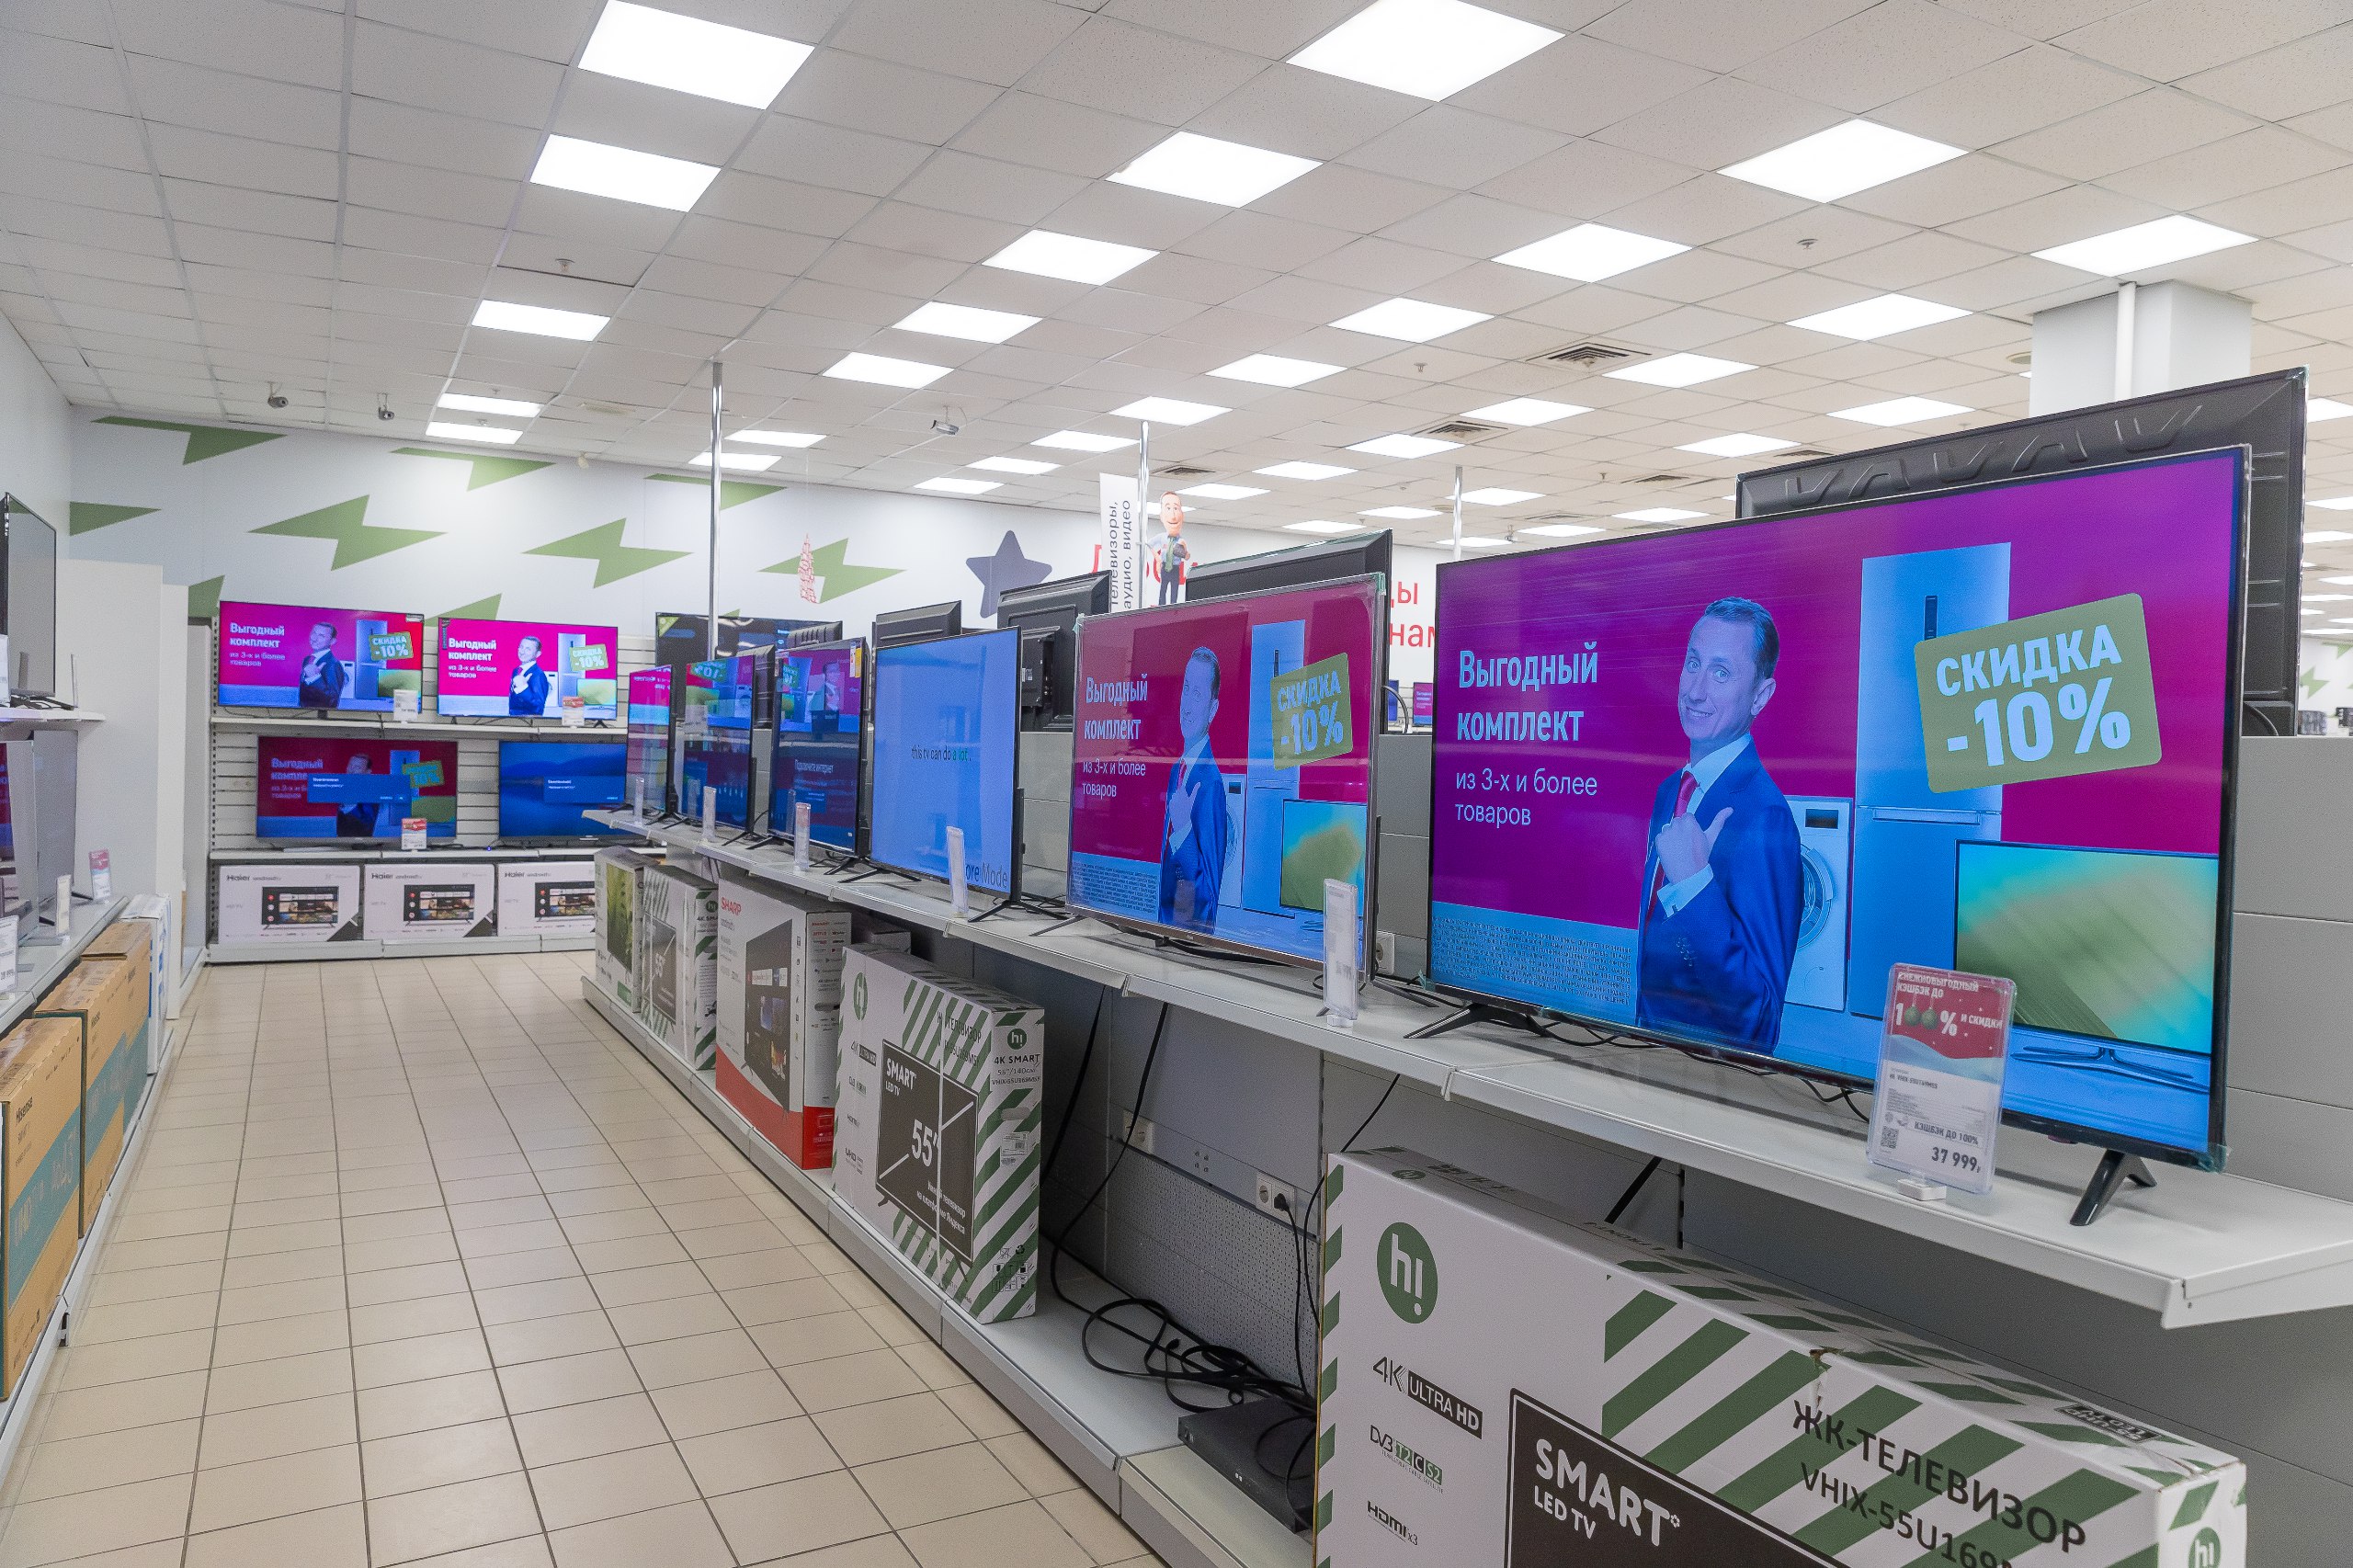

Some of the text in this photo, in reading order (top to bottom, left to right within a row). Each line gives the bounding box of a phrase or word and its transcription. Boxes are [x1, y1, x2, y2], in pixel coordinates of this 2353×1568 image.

[1122, 500, 1132, 609] аудио, видео
[230, 622, 285, 636] Выгодный
[372, 636, 407, 645] СКИДКА
[230, 638, 280, 648] комплект
[374, 644, 409, 657] -10%
[449, 638, 496, 651] Выгодный
[449, 652, 493, 662] комплект
[574, 654, 605, 667] -10%
[1459, 641, 1598, 692] Выгодный
[1936, 624, 2122, 697] СКИДКА
[1086, 673, 1148, 707] Выгодный
[1277, 670, 1342, 712] СКИДКА
[1085, 719, 1142, 740] комплект
[1280, 700, 1344, 755] -10%
[1457, 710, 1585, 743] комплект
[1947, 676, 2131, 767] -10%
[912, 744, 923, 759] this
[924, 748, 930, 759] tv
[930, 749, 942, 761] can
[943, 745, 951, 761] do
[271, 771, 308, 780] компле
[1083, 757, 1146, 776] из 3-х и более
[1082, 782, 1117, 800] товаров
[1456, 767, 1598, 796] из 3-х и более
[1454, 803, 1532, 828] товаров
[965, 862, 1008, 890] ore Mode
[722, 896, 741, 915] SHARP
[1897, 983, 1944, 999] КЭШБЭК ДО
[1969, 1015, 2003, 1028] СКИДКИ
[995, 1054, 1040, 1064] 4K SMART
[887, 1057, 915, 1090] SMART
[886, 1080, 900, 1096] LED TV
[16, 1096, 33, 1124] Hisense
[1915, 1121, 1979, 1145] КЭШБЭК ДО 100%
[1931, 1146, 1948, 1164] 37
[1372, 1356, 1480, 1431] 4K ULTRA HD
[1792, 1400, 2086, 1553] ЖК-ТЕЛЕВИЗОР
[1536, 1438, 1670, 1547] SMART
[1534, 1485, 1597, 1540] LED TV
[1801, 1461, 2013, 1568] VHIX-55U169
